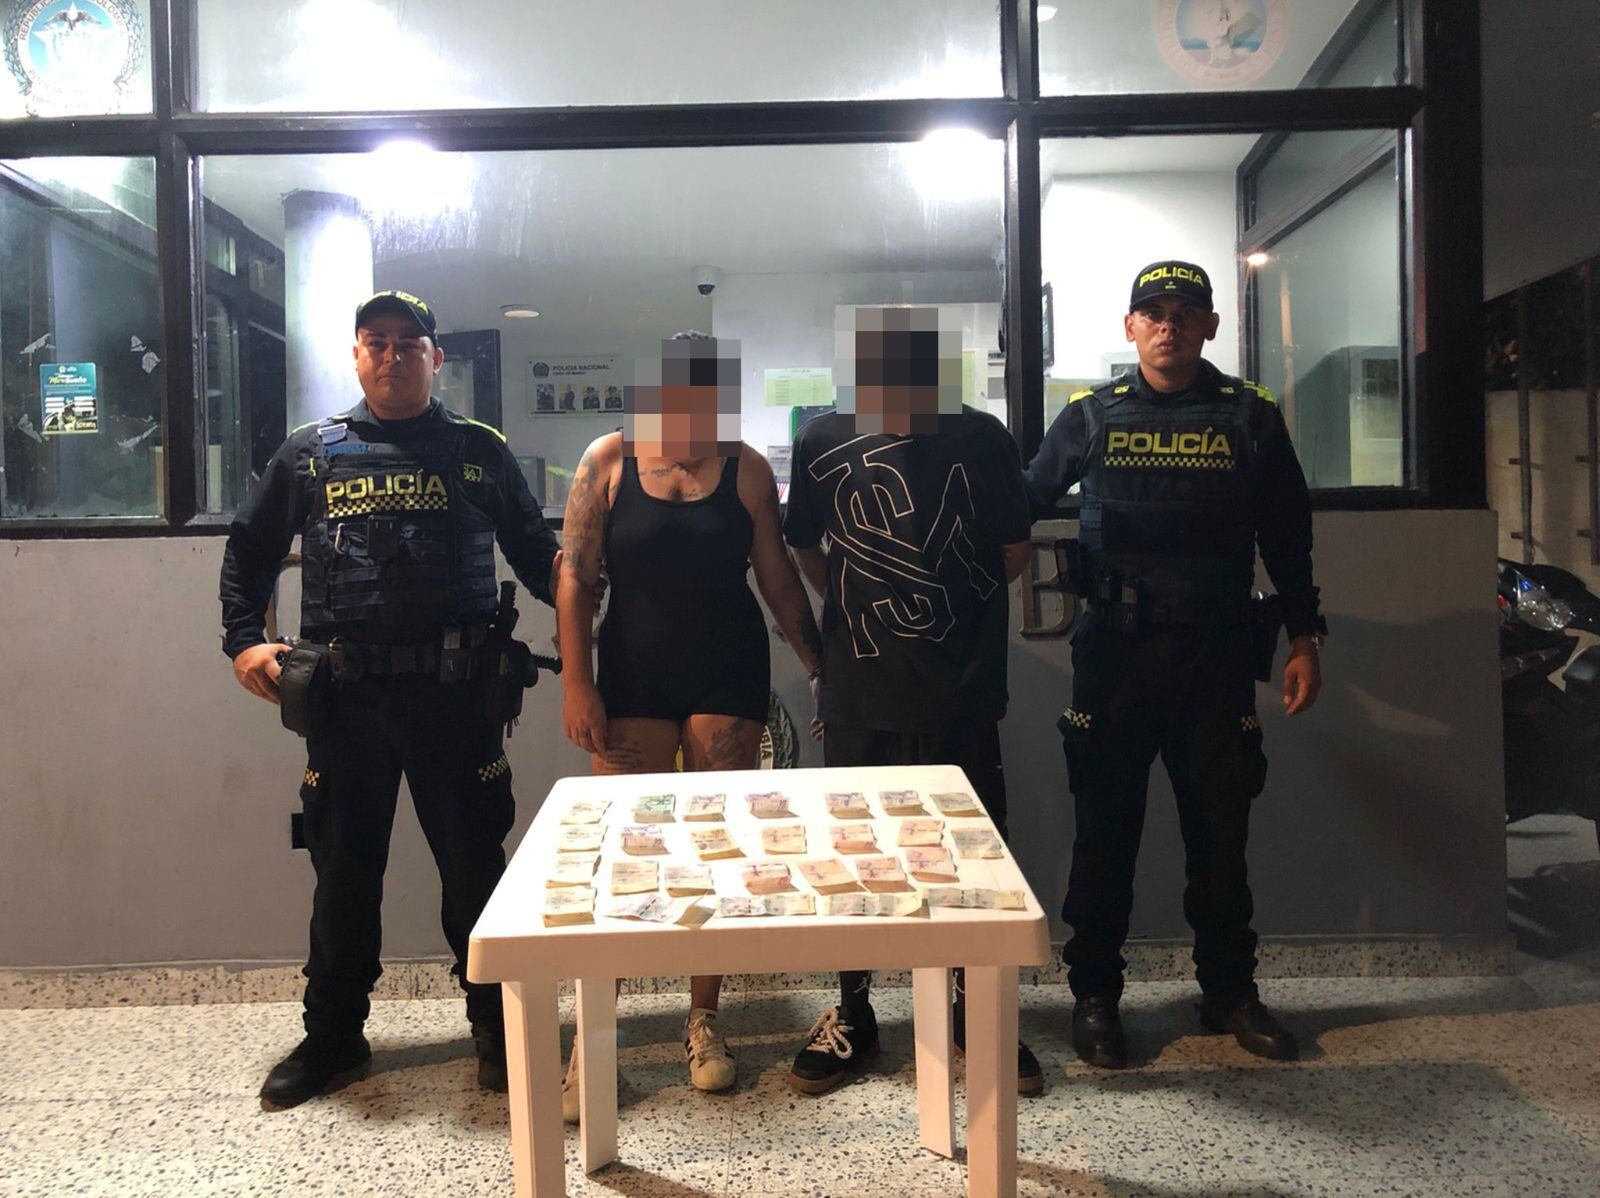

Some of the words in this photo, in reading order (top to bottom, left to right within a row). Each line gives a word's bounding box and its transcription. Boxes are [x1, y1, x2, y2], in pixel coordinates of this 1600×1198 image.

[1139, 267, 1204, 287] POLICÍA
[1107, 426, 1232, 456] POLICÍA
[325, 469, 448, 503] POLICÍA
